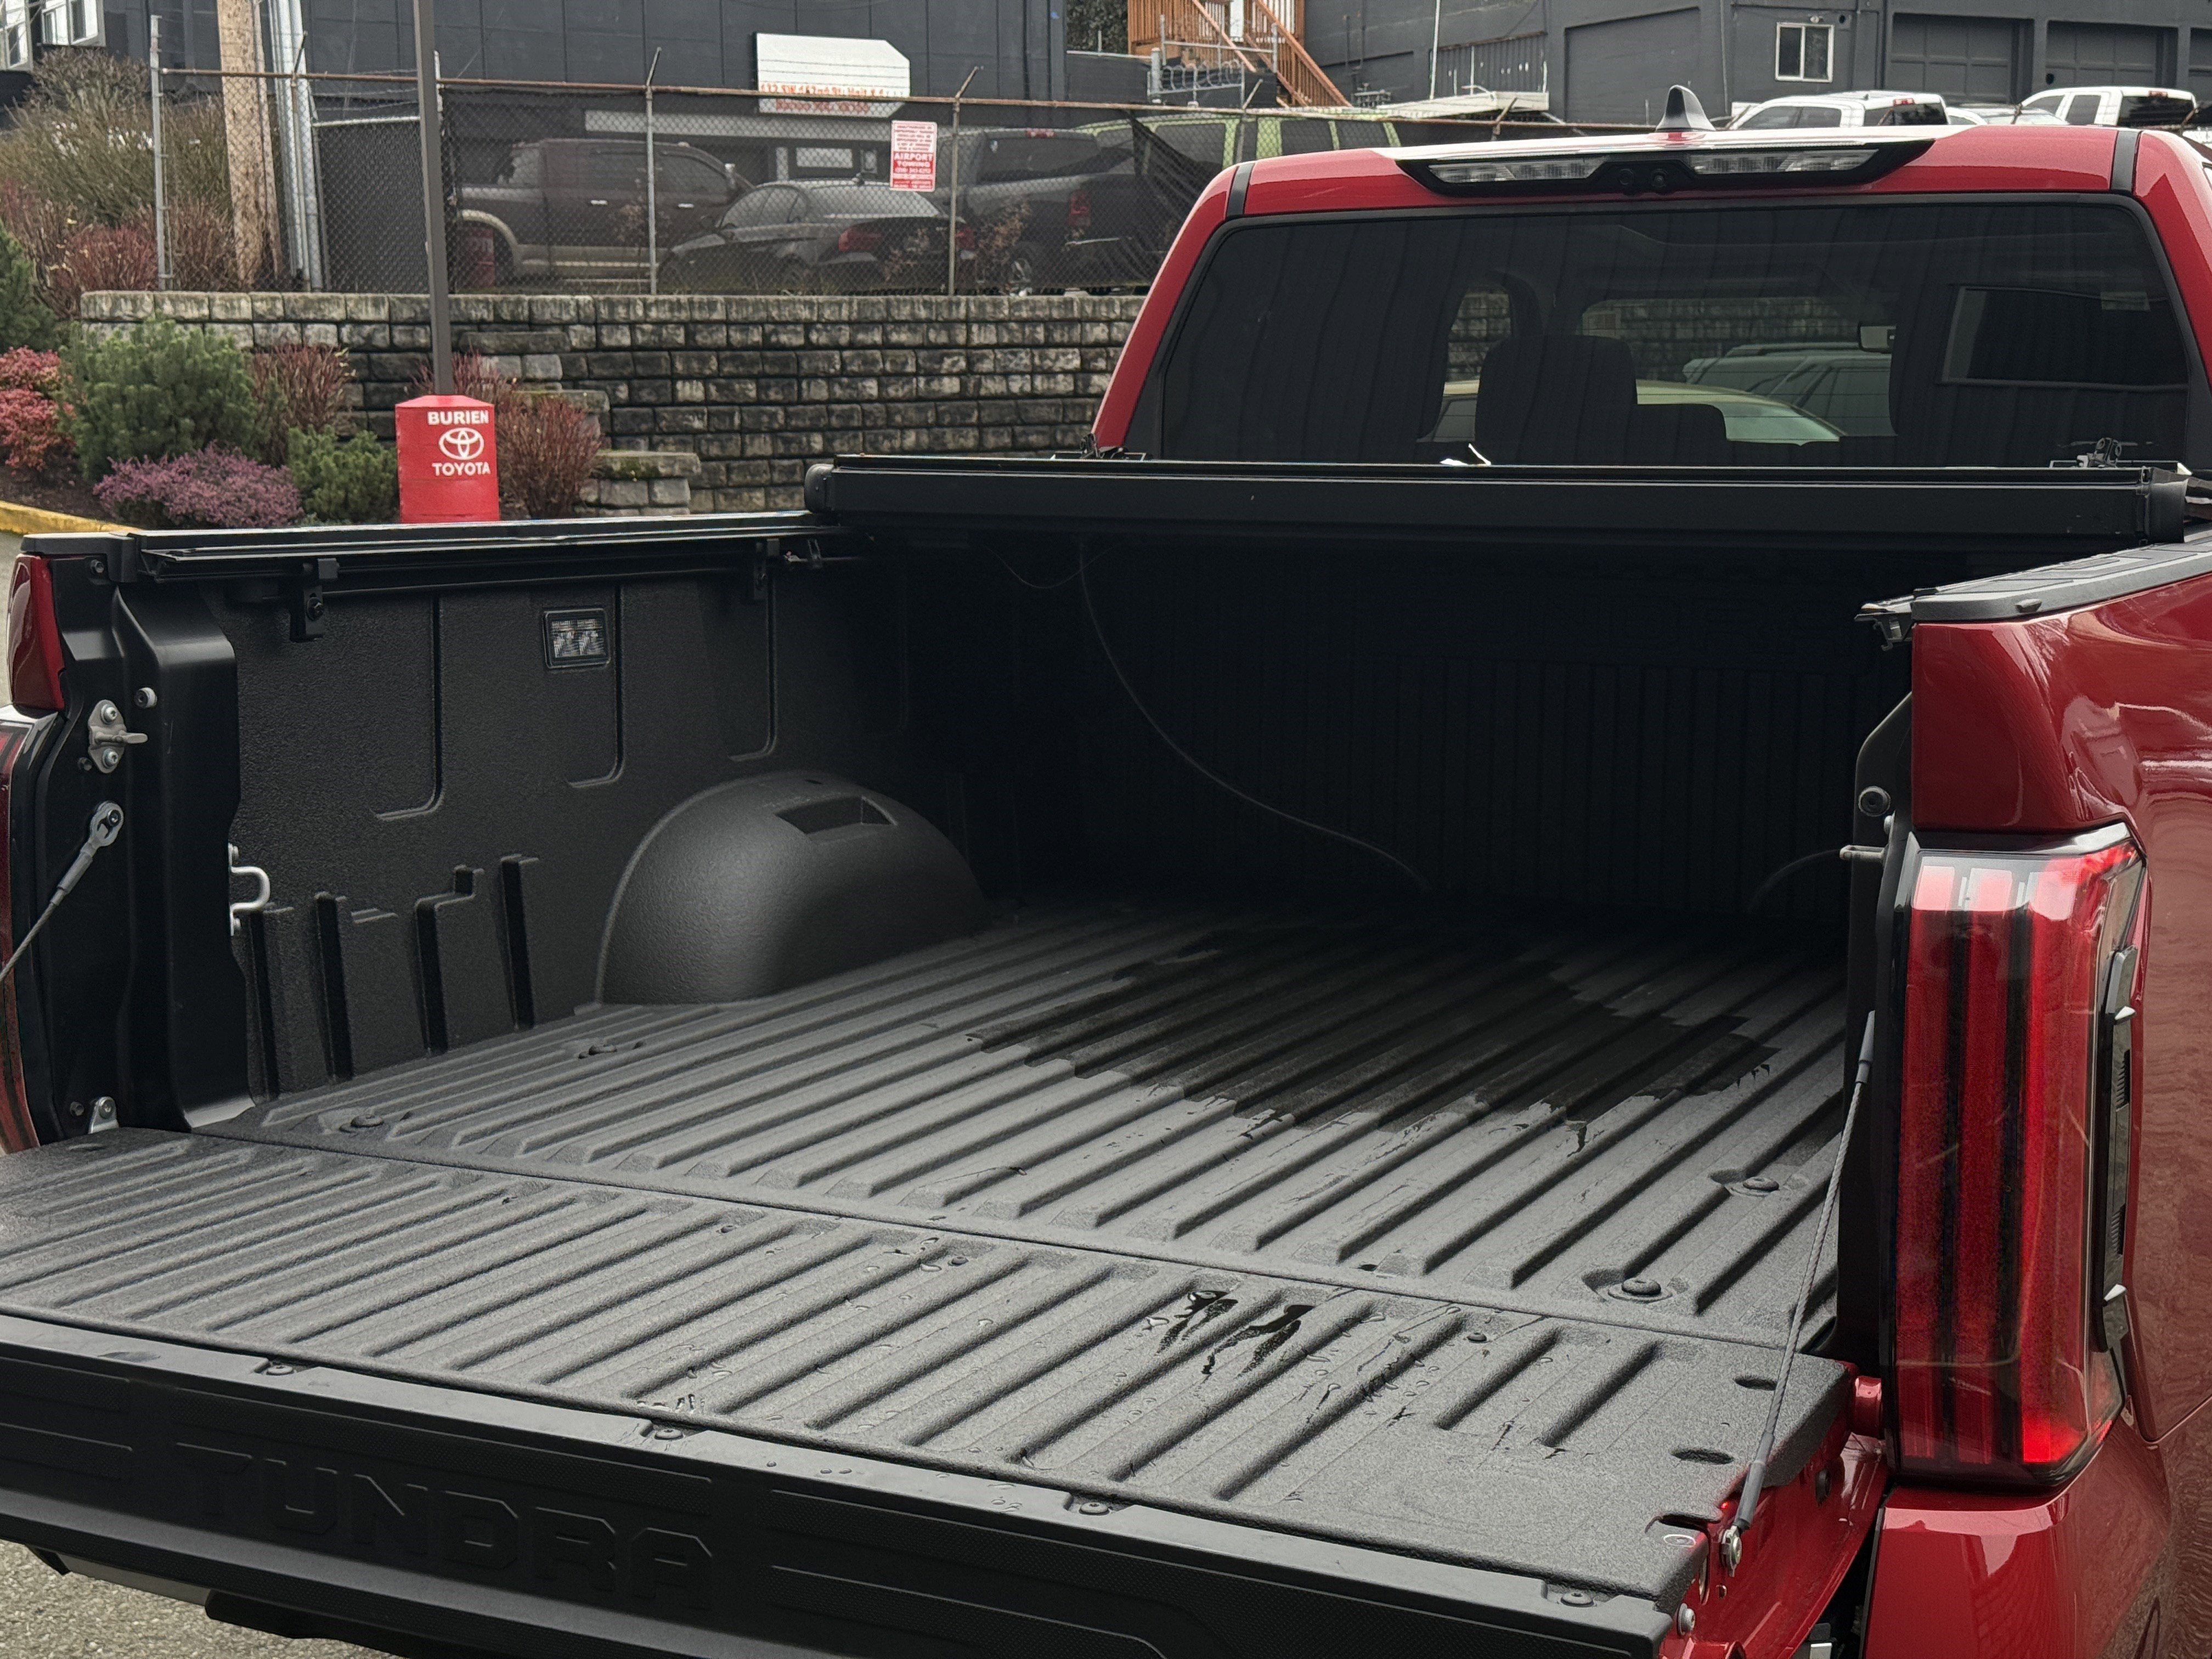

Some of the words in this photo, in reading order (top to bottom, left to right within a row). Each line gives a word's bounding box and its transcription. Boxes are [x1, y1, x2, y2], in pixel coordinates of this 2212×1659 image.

[894, 153, 933, 161] AIRPORT
[427, 410, 489, 425] BURIEN
[432, 462, 491, 476] TOYOTA
[175, 1442, 713, 1611] TUNDRA
